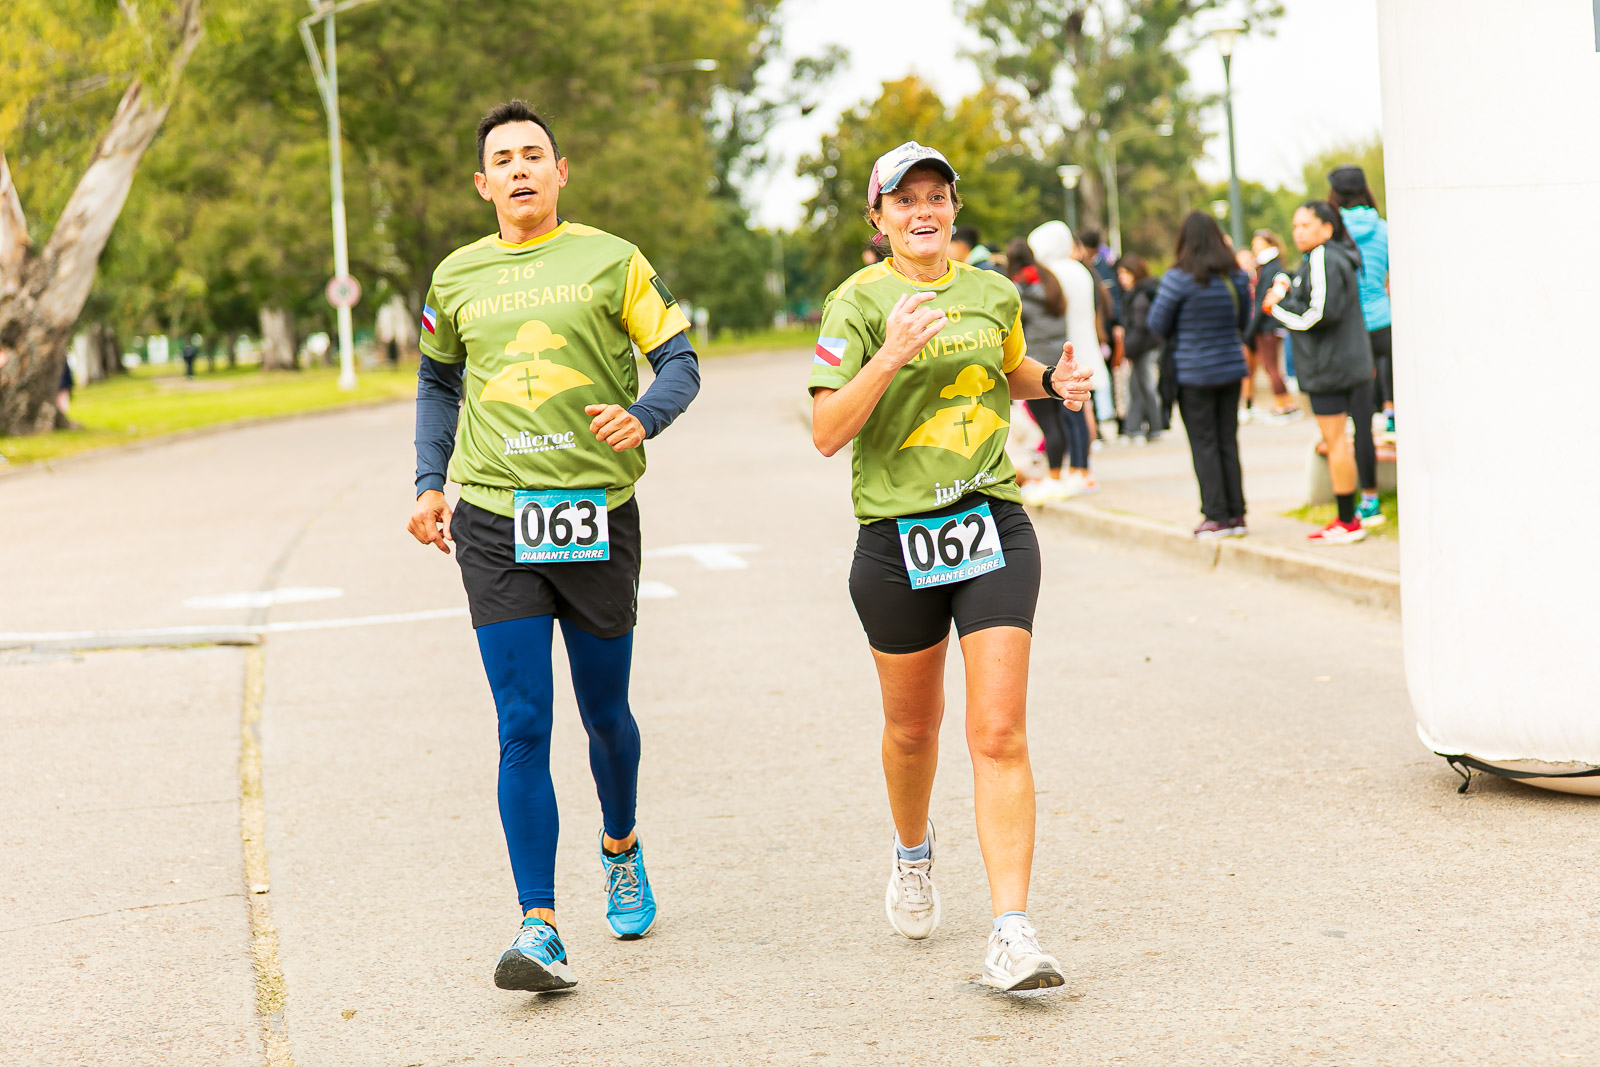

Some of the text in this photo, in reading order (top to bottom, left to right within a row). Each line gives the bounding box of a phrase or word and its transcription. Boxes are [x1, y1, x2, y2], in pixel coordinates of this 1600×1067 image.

[459, 283, 594, 326] ANIVERSARIO
[501, 430, 575, 456] julicroc
[520, 499, 599, 549] 063
[520, 549, 605, 561] DIAMANTE CORRE
[907, 512, 995, 573] 062
[915, 558, 1001, 587] DIAMANTE CORRE
